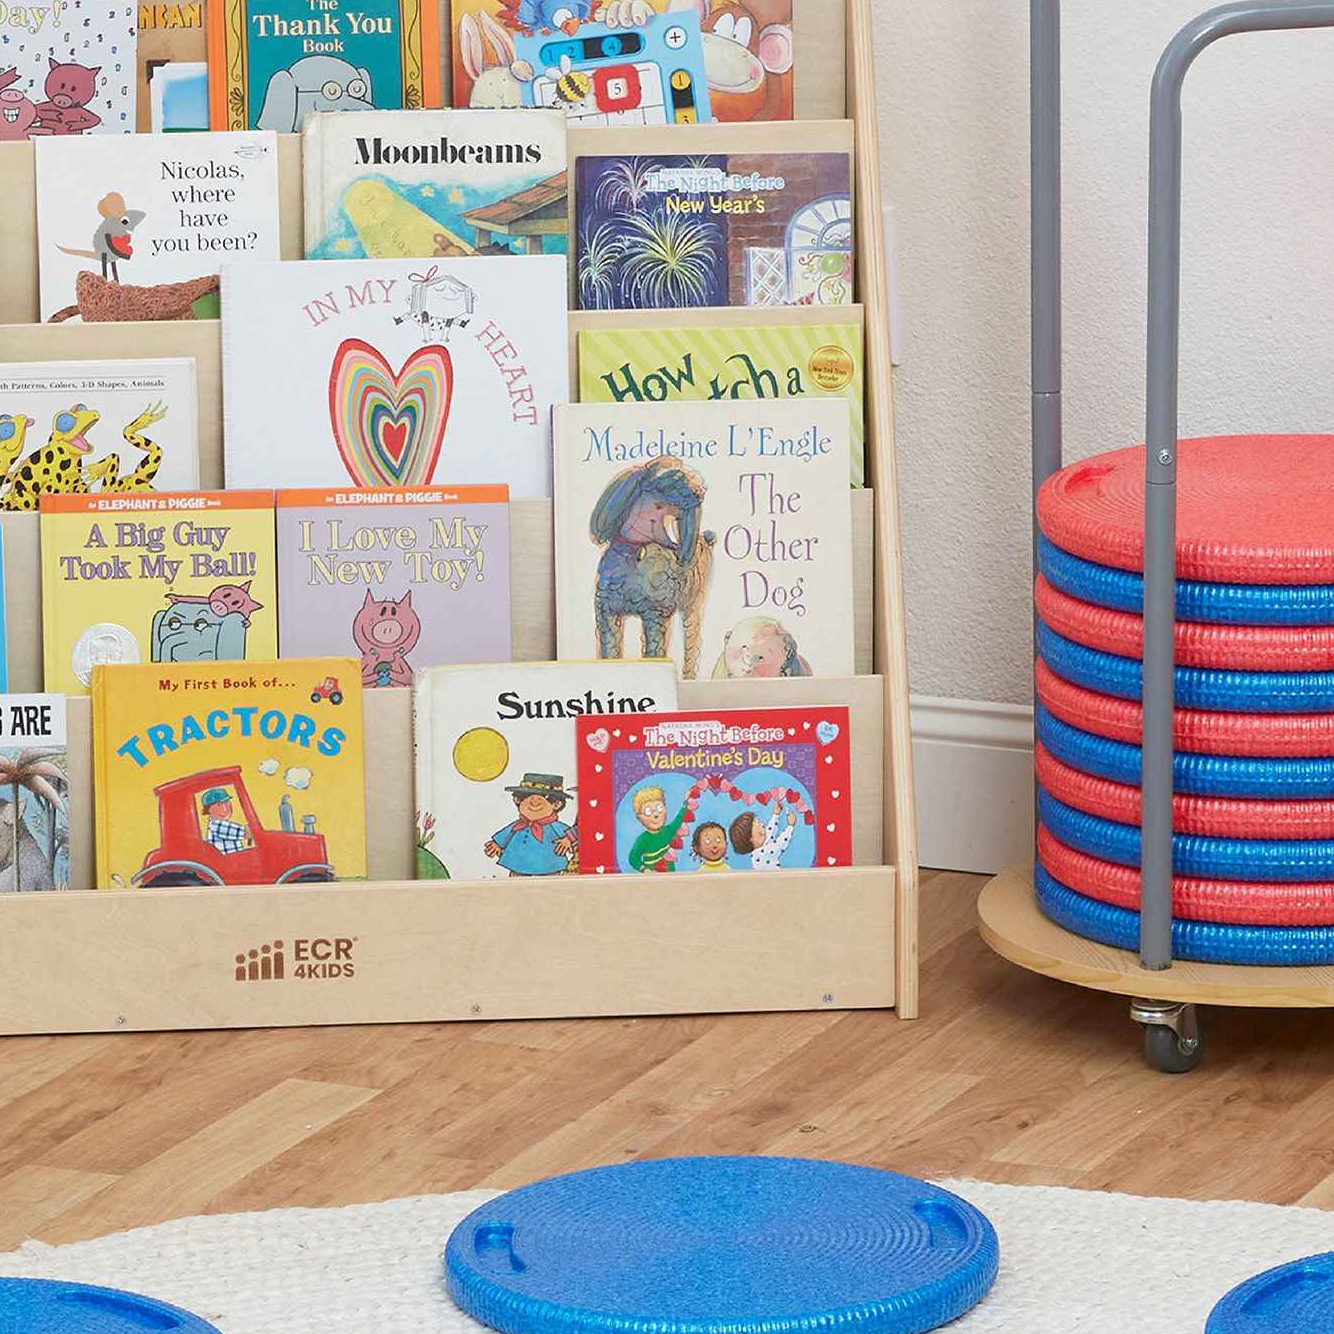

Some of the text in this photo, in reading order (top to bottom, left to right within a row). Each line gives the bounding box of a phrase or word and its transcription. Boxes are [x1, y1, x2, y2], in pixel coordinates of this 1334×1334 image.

[252, 12, 393, 37] Thank You
[302, 38, 345, 53] Book
[548, 41, 616, 62] 1 2 4
[614, 83, 622, 95] 5
[677, 75, 683, 86] 1
[354, 136, 542, 165] Moonbeams
[159, 161, 245, 182] Nicolas,
[647, 173, 785, 191] The Night Before
[171, 185, 236, 204] where
[666, 196, 705, 215] New
[179, 210, 229, 228] have
[152, 232, 258, 257] you been?
[301, 280, 538, 426] IN MY HEART
[49, 381, 78, 389] Colors,
[97, 380, 127, 389] Shapes,
[600, 353, 695, 402] How
[786, 367, 805, 396] a
[582, 424, 833, 463] Madeleine L'Engle
[98, 499, 157, 510] ELEPHANT
[158, 500, 167, 509] &
[168, 498, 206, 509] PIGGIE
[335, 493, 394, 504] ELEPHANT
[395, 494, 404, 503] &
[405, 492, 442, 503] PIGGIE
[738, 473, 801, 517] The
[84, 521, 231, 553] A Big Guy
[299, 517, 488, 557] I Love My
[723, 519, 819, 563] Other
[60, 552, 257, 585] Took My Ball!
[307, 550, 486, 591] New Toy!
[739, 570, 806, 618] Dog
[159, 679, 179, 692] My
[184, 678, 217, 689] First
[223, 677, 257, 689] Book
[496, 690, 656, 720] Sunshine
[9, 705, 53, 736] ARE
[117, 706, 347, 767] TRACTORS
[645, 725, 784, 745] The Night Before
[646, 747, 783, 769] Valentine's Day
[294, 963, 355, 979] 4KIDS
